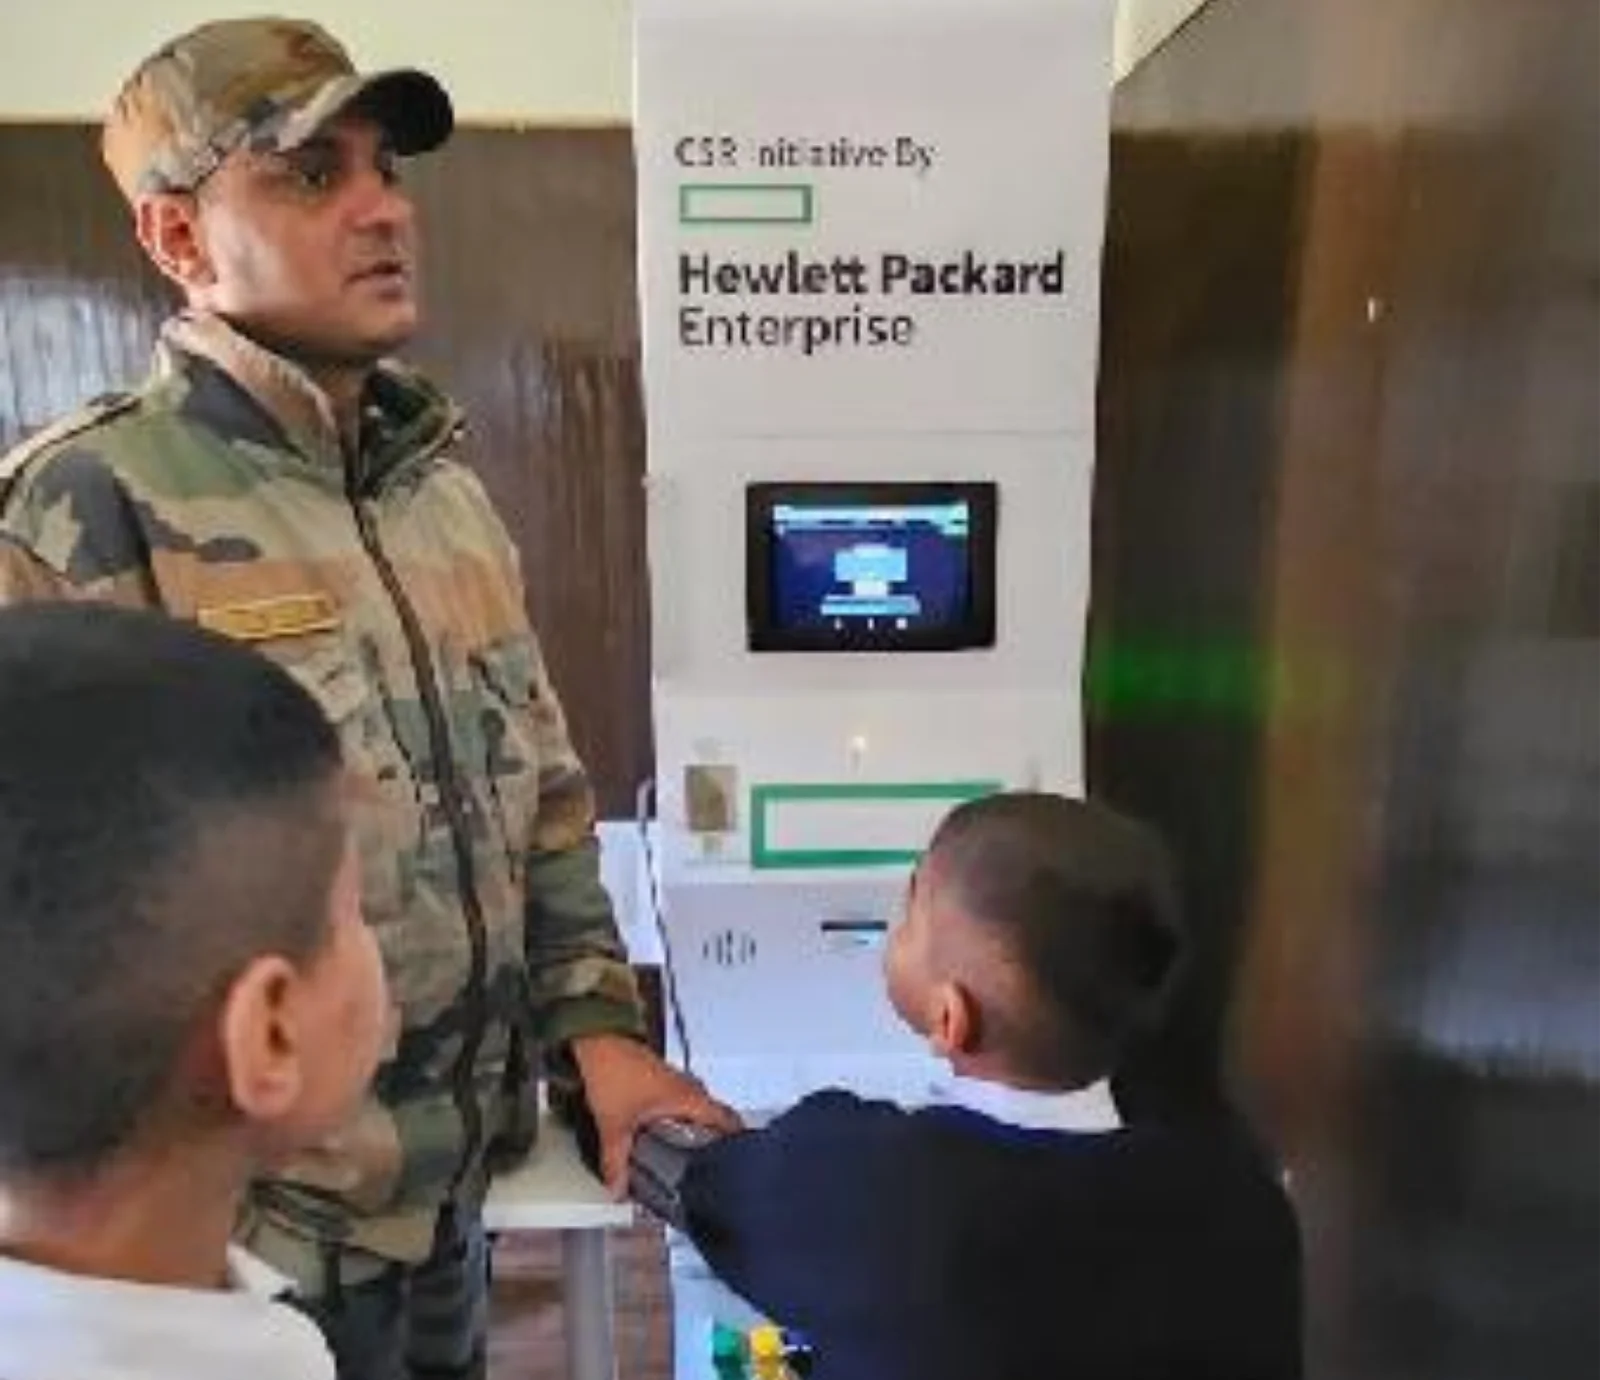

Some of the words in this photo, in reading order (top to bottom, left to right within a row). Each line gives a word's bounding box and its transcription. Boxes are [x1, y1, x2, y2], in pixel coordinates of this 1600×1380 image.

[674, 136, 738, 167] CSR
[748, 136, 888, 168] nitative
[896, 136, 934, 176] By
[679, 251, 868, 295] Hewlett
[880, 250, 1065, 295] Packard
[678, 304, 914, 355] Enterprise
